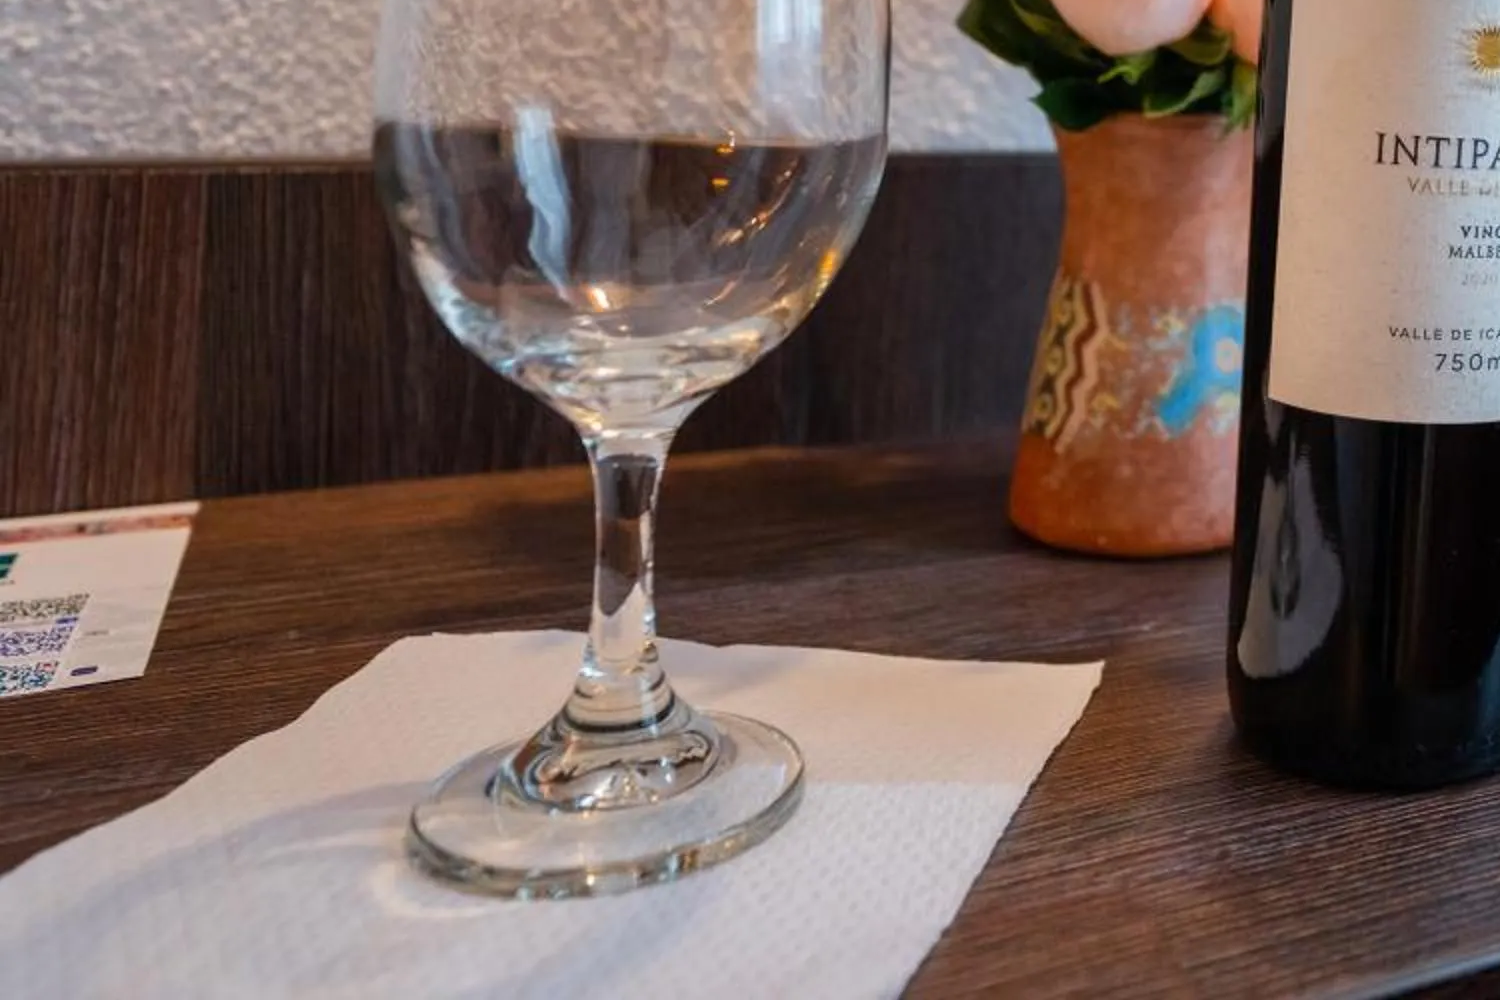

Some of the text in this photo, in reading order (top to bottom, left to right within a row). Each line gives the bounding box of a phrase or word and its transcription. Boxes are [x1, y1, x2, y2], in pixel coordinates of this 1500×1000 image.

[1407, 177, 1469, 196] VALLE
[1388, 326, 1442, 341] VALLE
[1451, 329, 1473, 341] DE
